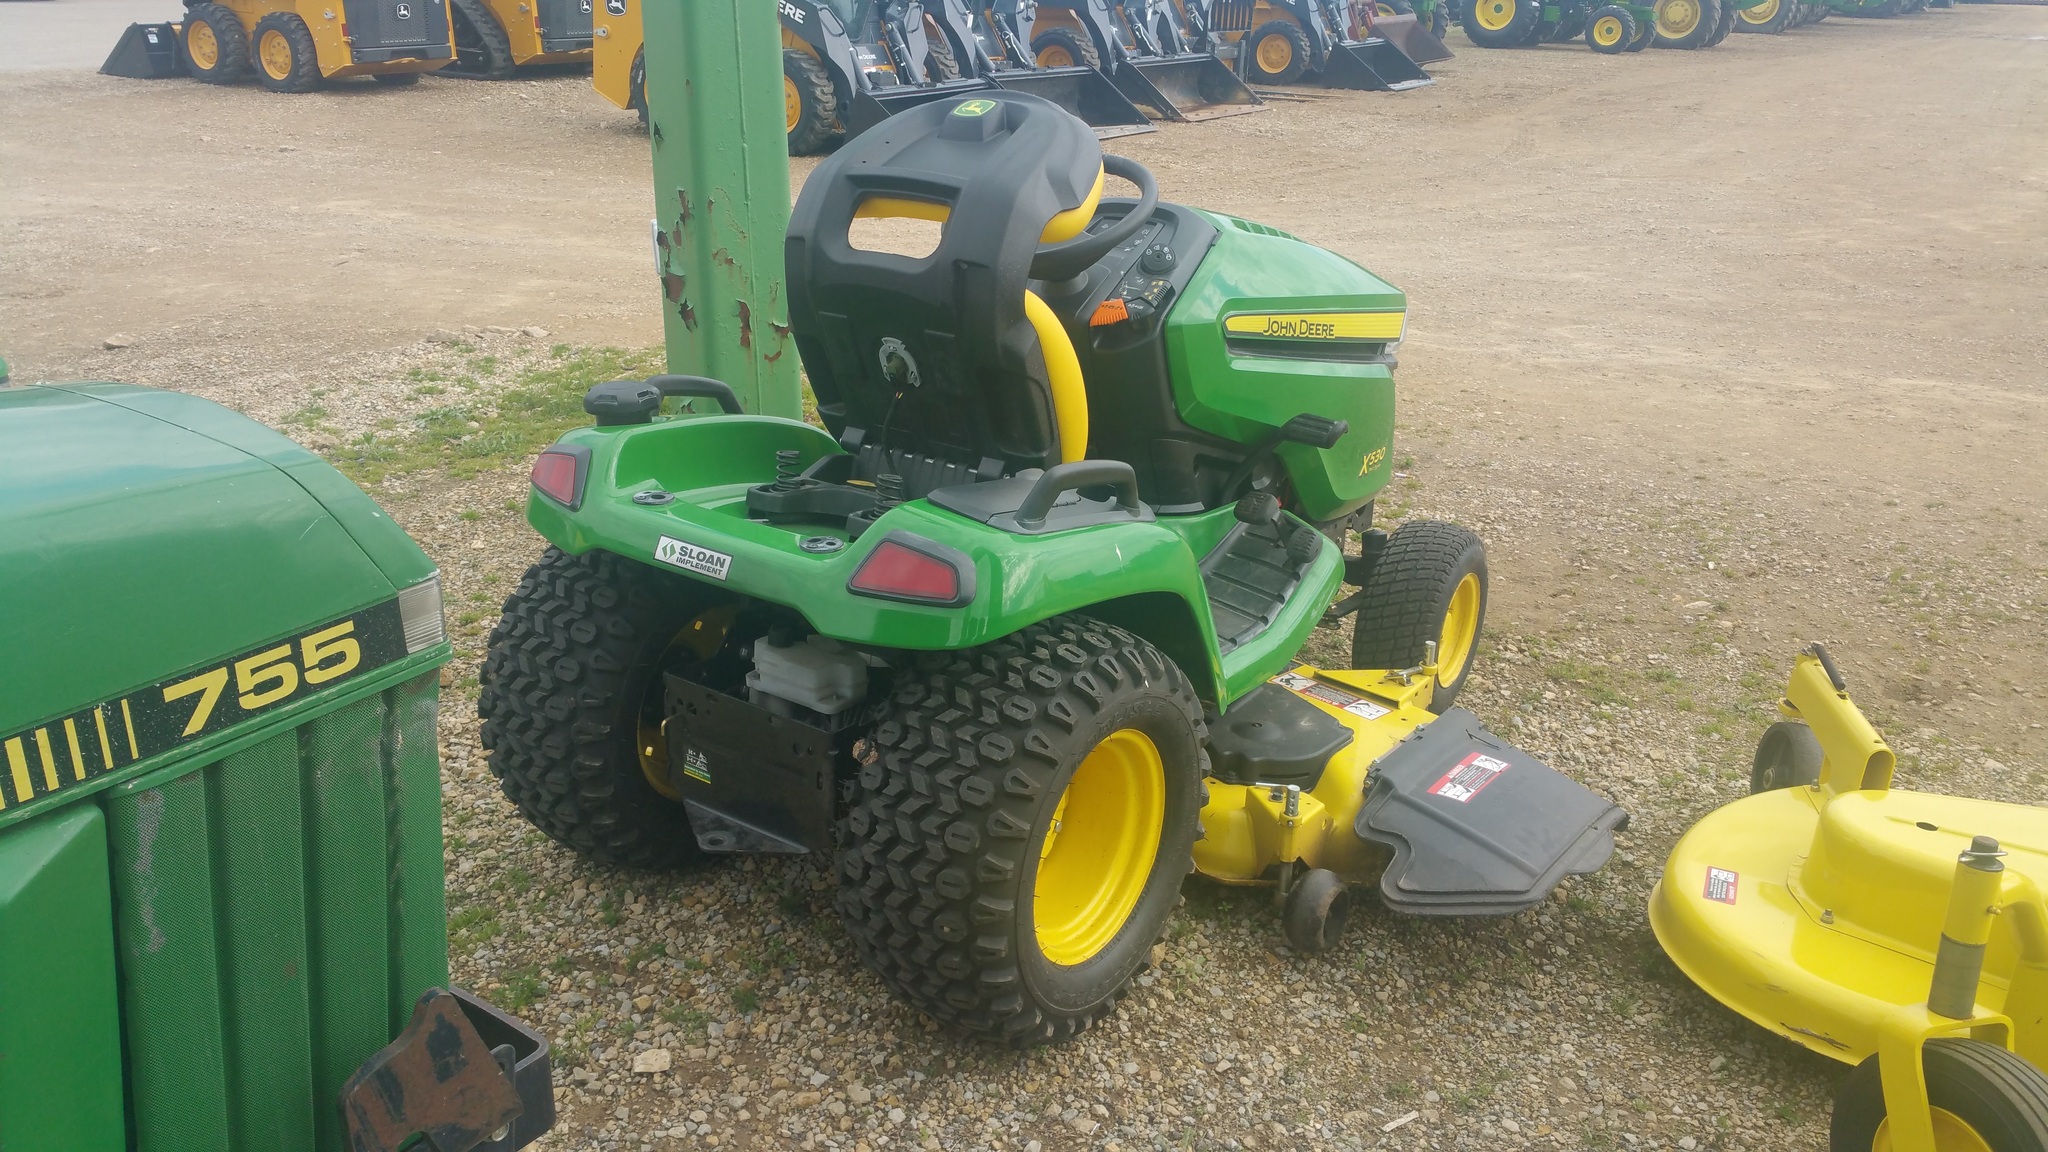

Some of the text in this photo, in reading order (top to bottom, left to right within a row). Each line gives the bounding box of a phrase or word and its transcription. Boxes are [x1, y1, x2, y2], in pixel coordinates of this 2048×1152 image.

[1263, 317, 1336, 337] JOHN DEERE
[1358, 446, 1387, 477] X530
[675, 556, 723, 576] IMPLEMENT
[678, 545, 727, 569] SLOAN
[163, 620, 362, 738] 755
